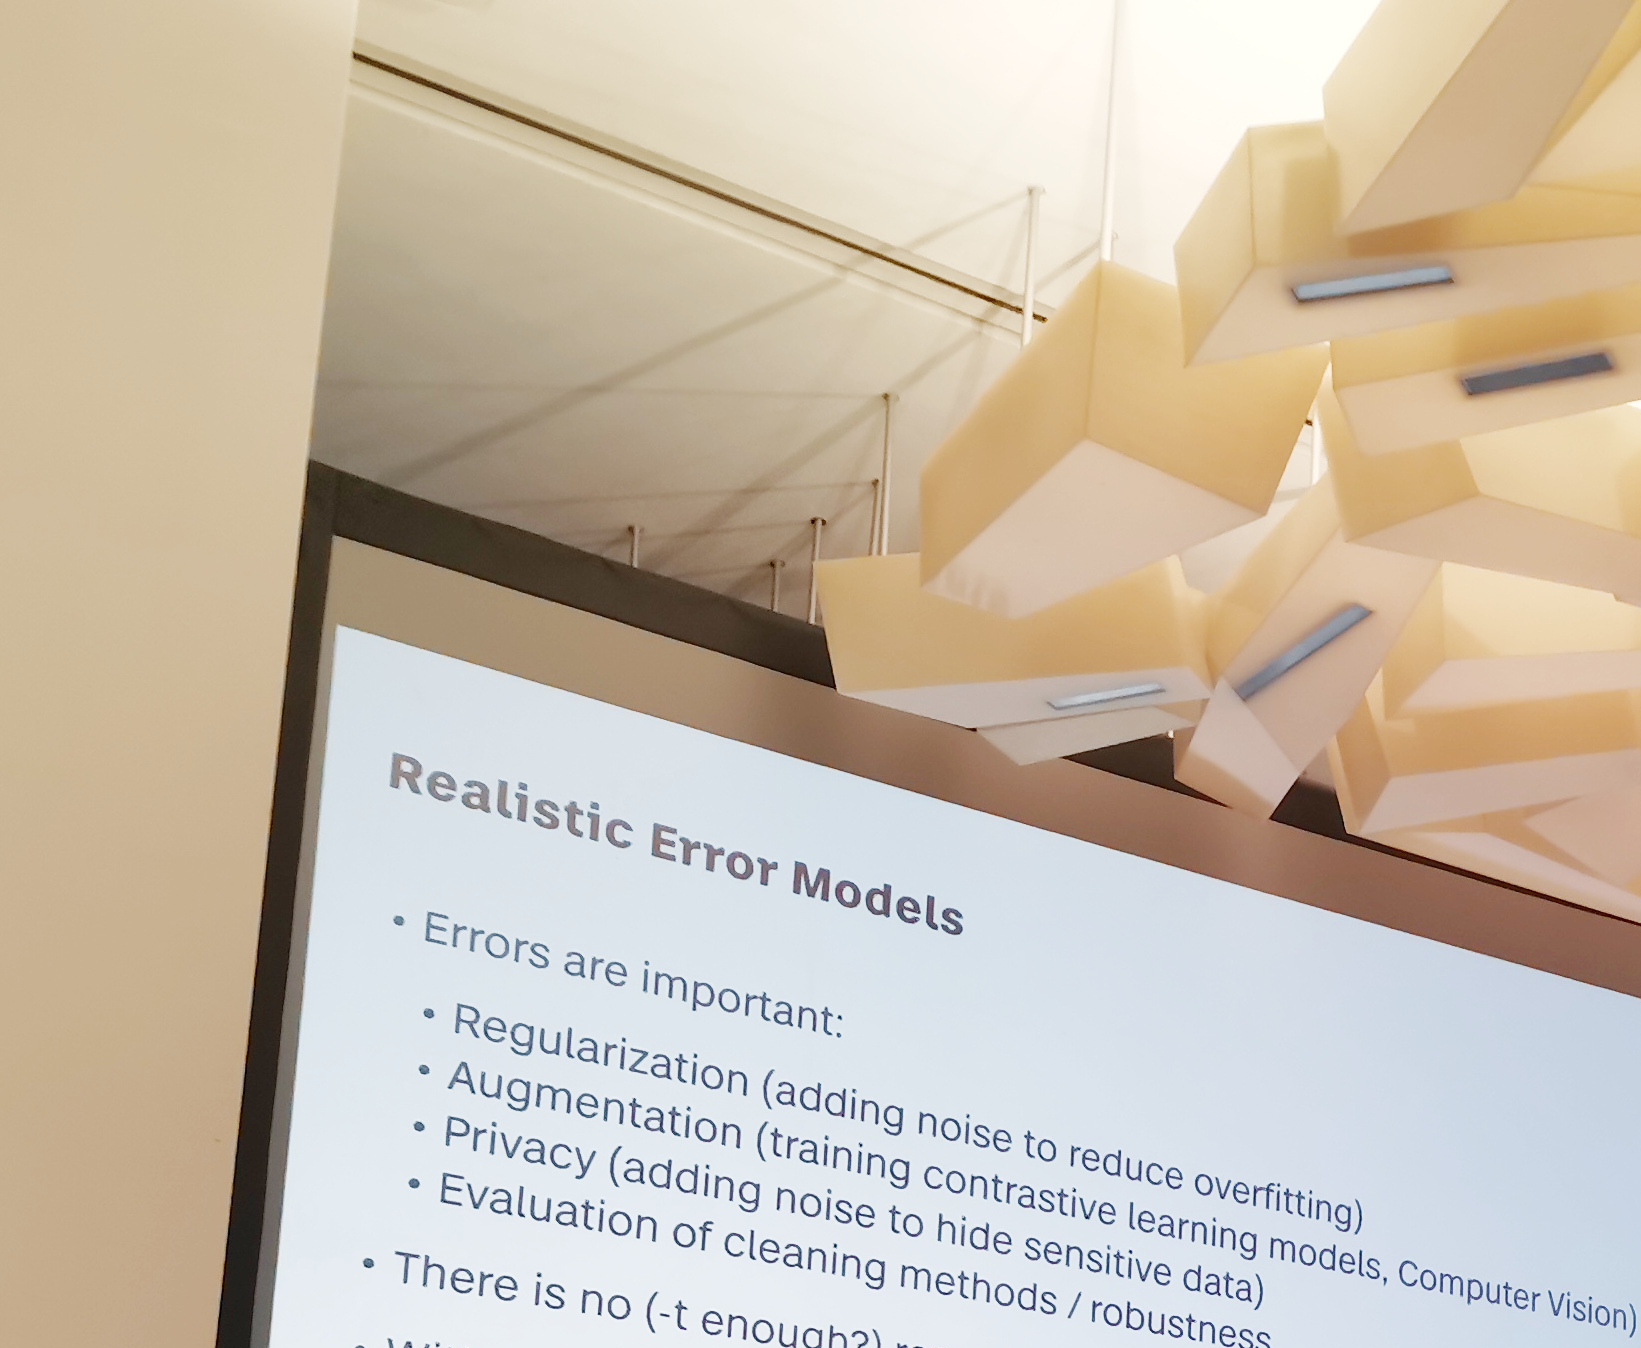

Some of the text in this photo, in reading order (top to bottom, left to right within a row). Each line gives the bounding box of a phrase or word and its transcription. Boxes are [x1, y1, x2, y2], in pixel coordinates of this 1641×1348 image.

[389, 751, 964, 936] Realistic Error Models
[424, 910, 843, 1039] Errors are important:
[446, 1060, 1637, 1339] Augmentation (training contrastive learning models, Computer Vision)
[454, 1002, 1363, 1236] Regularization (adding noise to reduce overfitting)
[394, 1250, 519, 1302] There
[533, 1271, 566, 1310] is
[580, 1288, 632, 1321] no
[645, 1290, 689, 1334] (-t
[439, 1171, 658, 1243] Evaluation
[672, 1220, 715, 1252] of
[723, 1228, 886, 1291] cleaning
[900, 1264, 1058, 1316] methods
[1066, 1291, 1083, 1320] /
[444, 1115, 1264, 1311] Privacy (adding noise to hide sensitive data)
